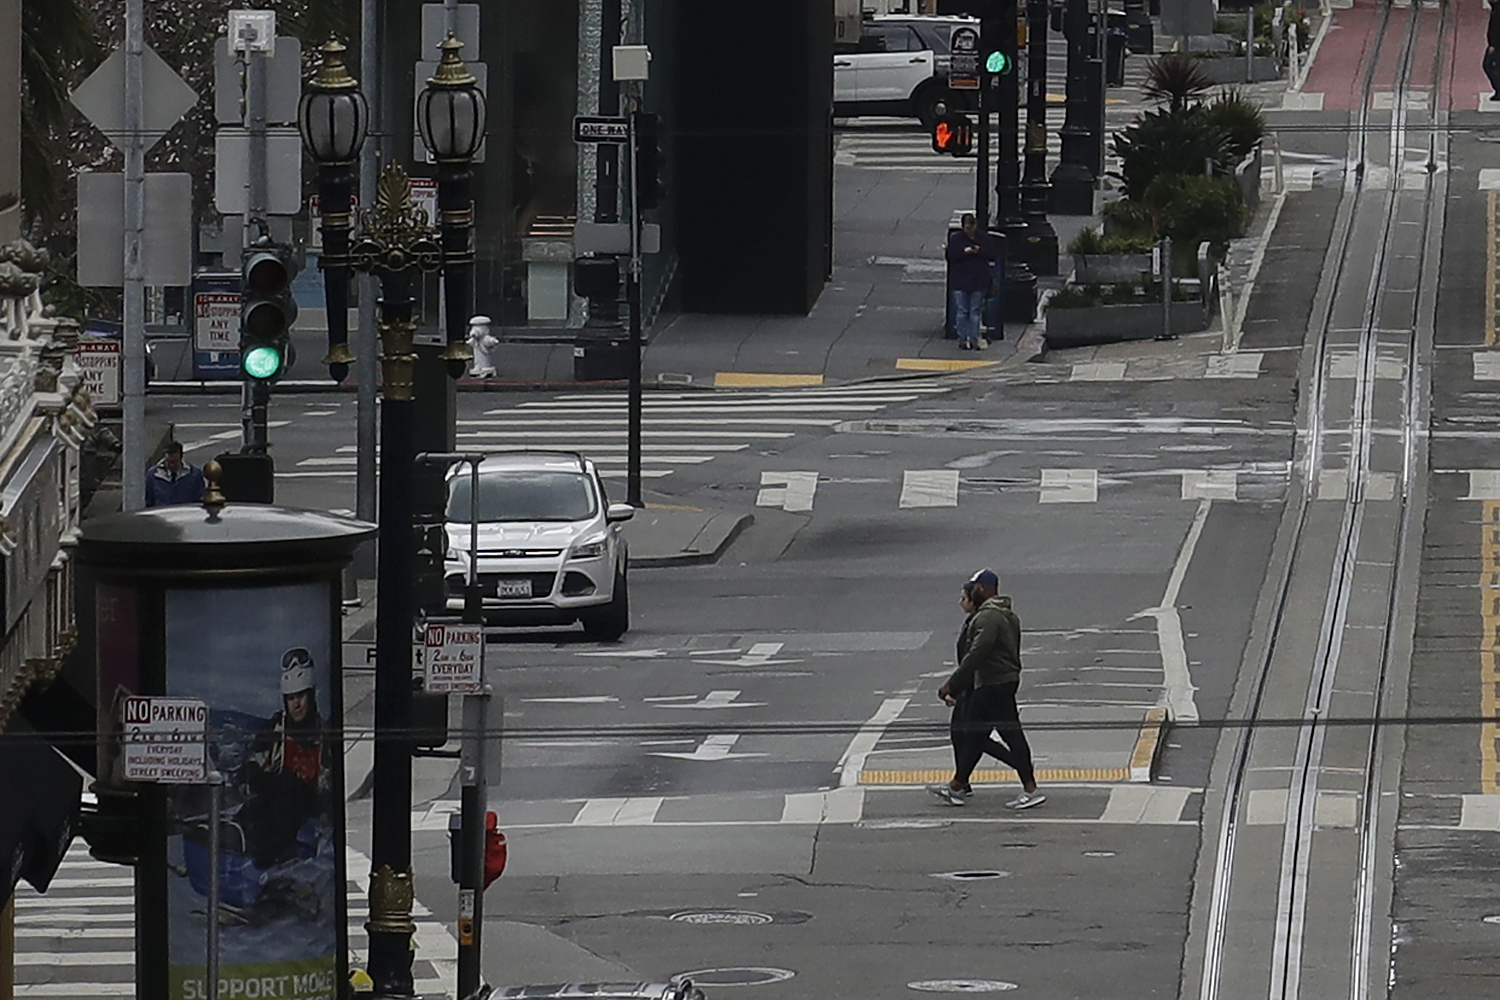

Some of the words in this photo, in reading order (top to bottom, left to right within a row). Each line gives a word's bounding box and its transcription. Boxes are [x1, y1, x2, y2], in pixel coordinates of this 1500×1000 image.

[582, 125, 601, 136] ONE
[210, 319, 229, 330] ANY
[209, 331, 231, 342] TIME
[427, 627, 444, 645] NO
[446, 631, 480, 645] PARKING
[431, 663, 474, 675] EVERYDAY
[127, 700, 149, 721] NO
[152, 705, 204, 721] PARKING
[130, 767, 158, 777] STREET
[161, 767, 200, 778] SWEEPING
[182, 975, 290, 1000] SUPPORT
[293, 969, 334, 996] MORE
